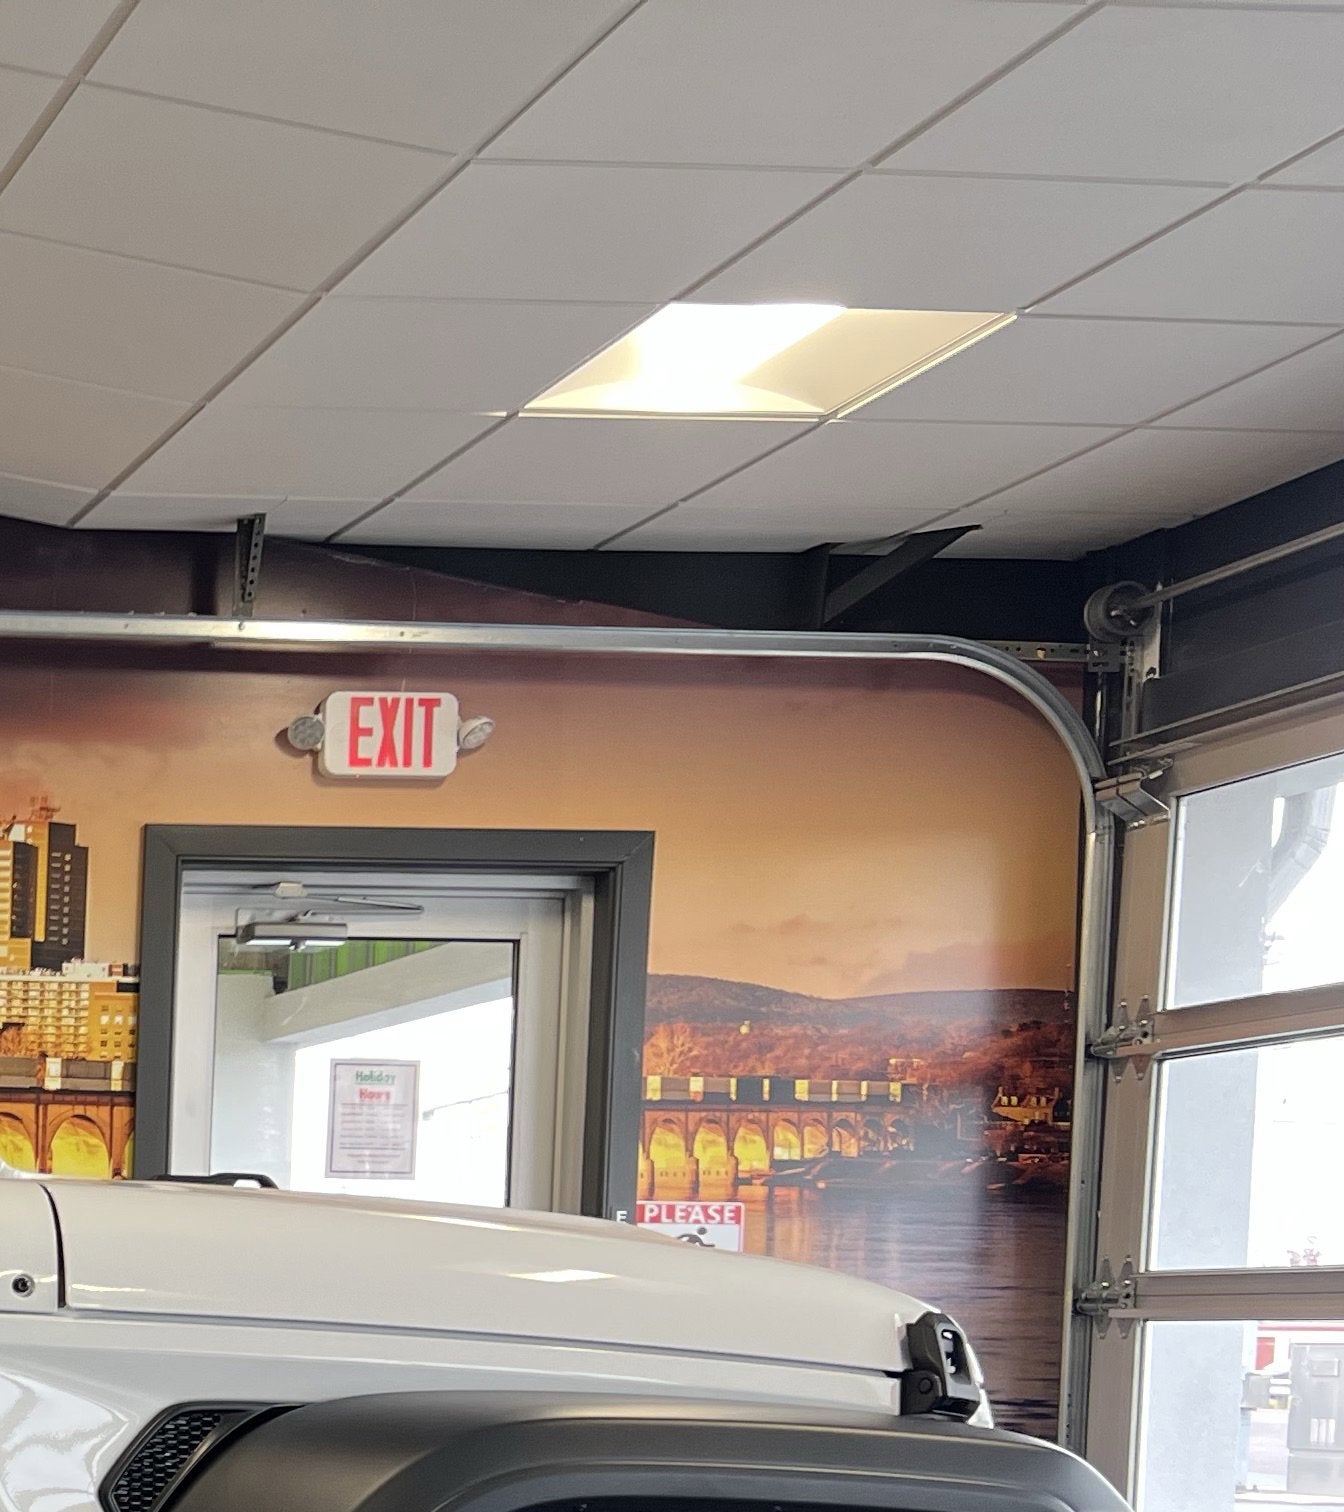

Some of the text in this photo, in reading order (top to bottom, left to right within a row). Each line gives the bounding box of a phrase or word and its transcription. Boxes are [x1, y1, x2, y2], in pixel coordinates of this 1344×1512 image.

[346, 696, 442, 769] EXIT
[355, 1070, 396, 1084] Holiday
[359, 1088, 391, 1101] Hours
[643, 1203, 737, 1224] PLEASE
